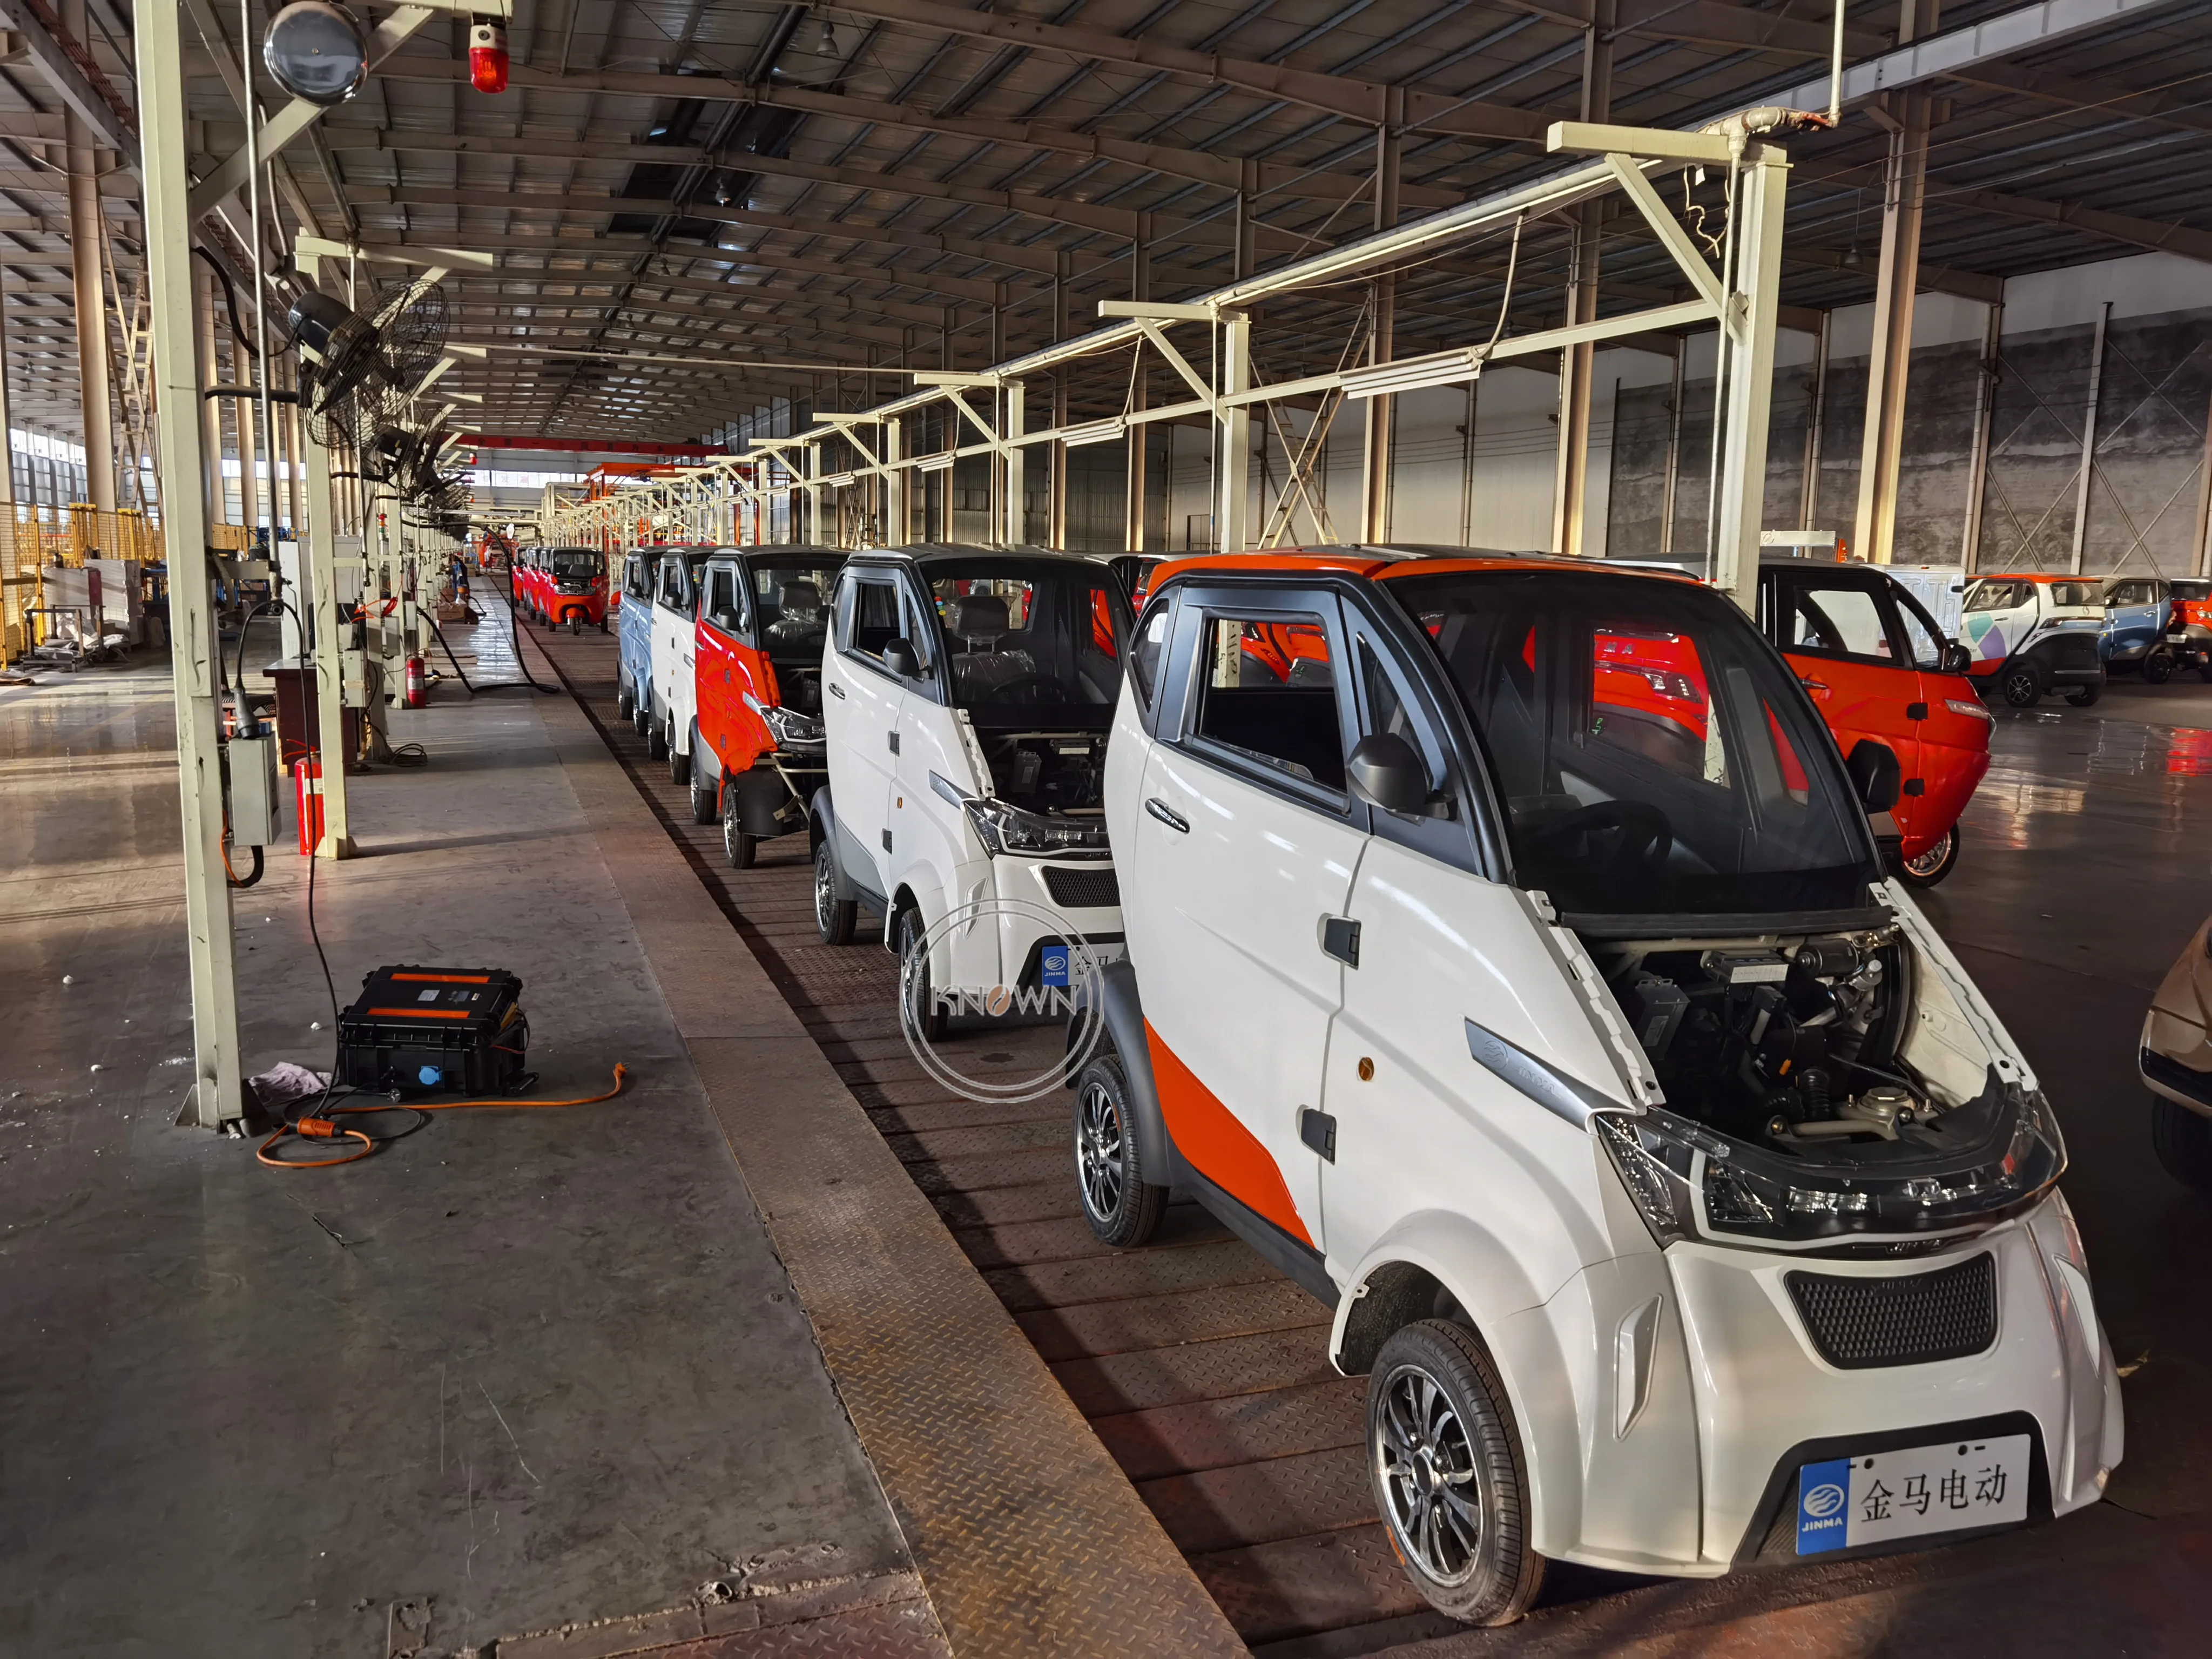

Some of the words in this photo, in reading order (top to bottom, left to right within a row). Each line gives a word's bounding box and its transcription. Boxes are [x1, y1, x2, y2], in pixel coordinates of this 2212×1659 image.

[1860, 1464, 2008, 1523] 金马电动
[1802, 1516, 1843, 1532] JINMA
